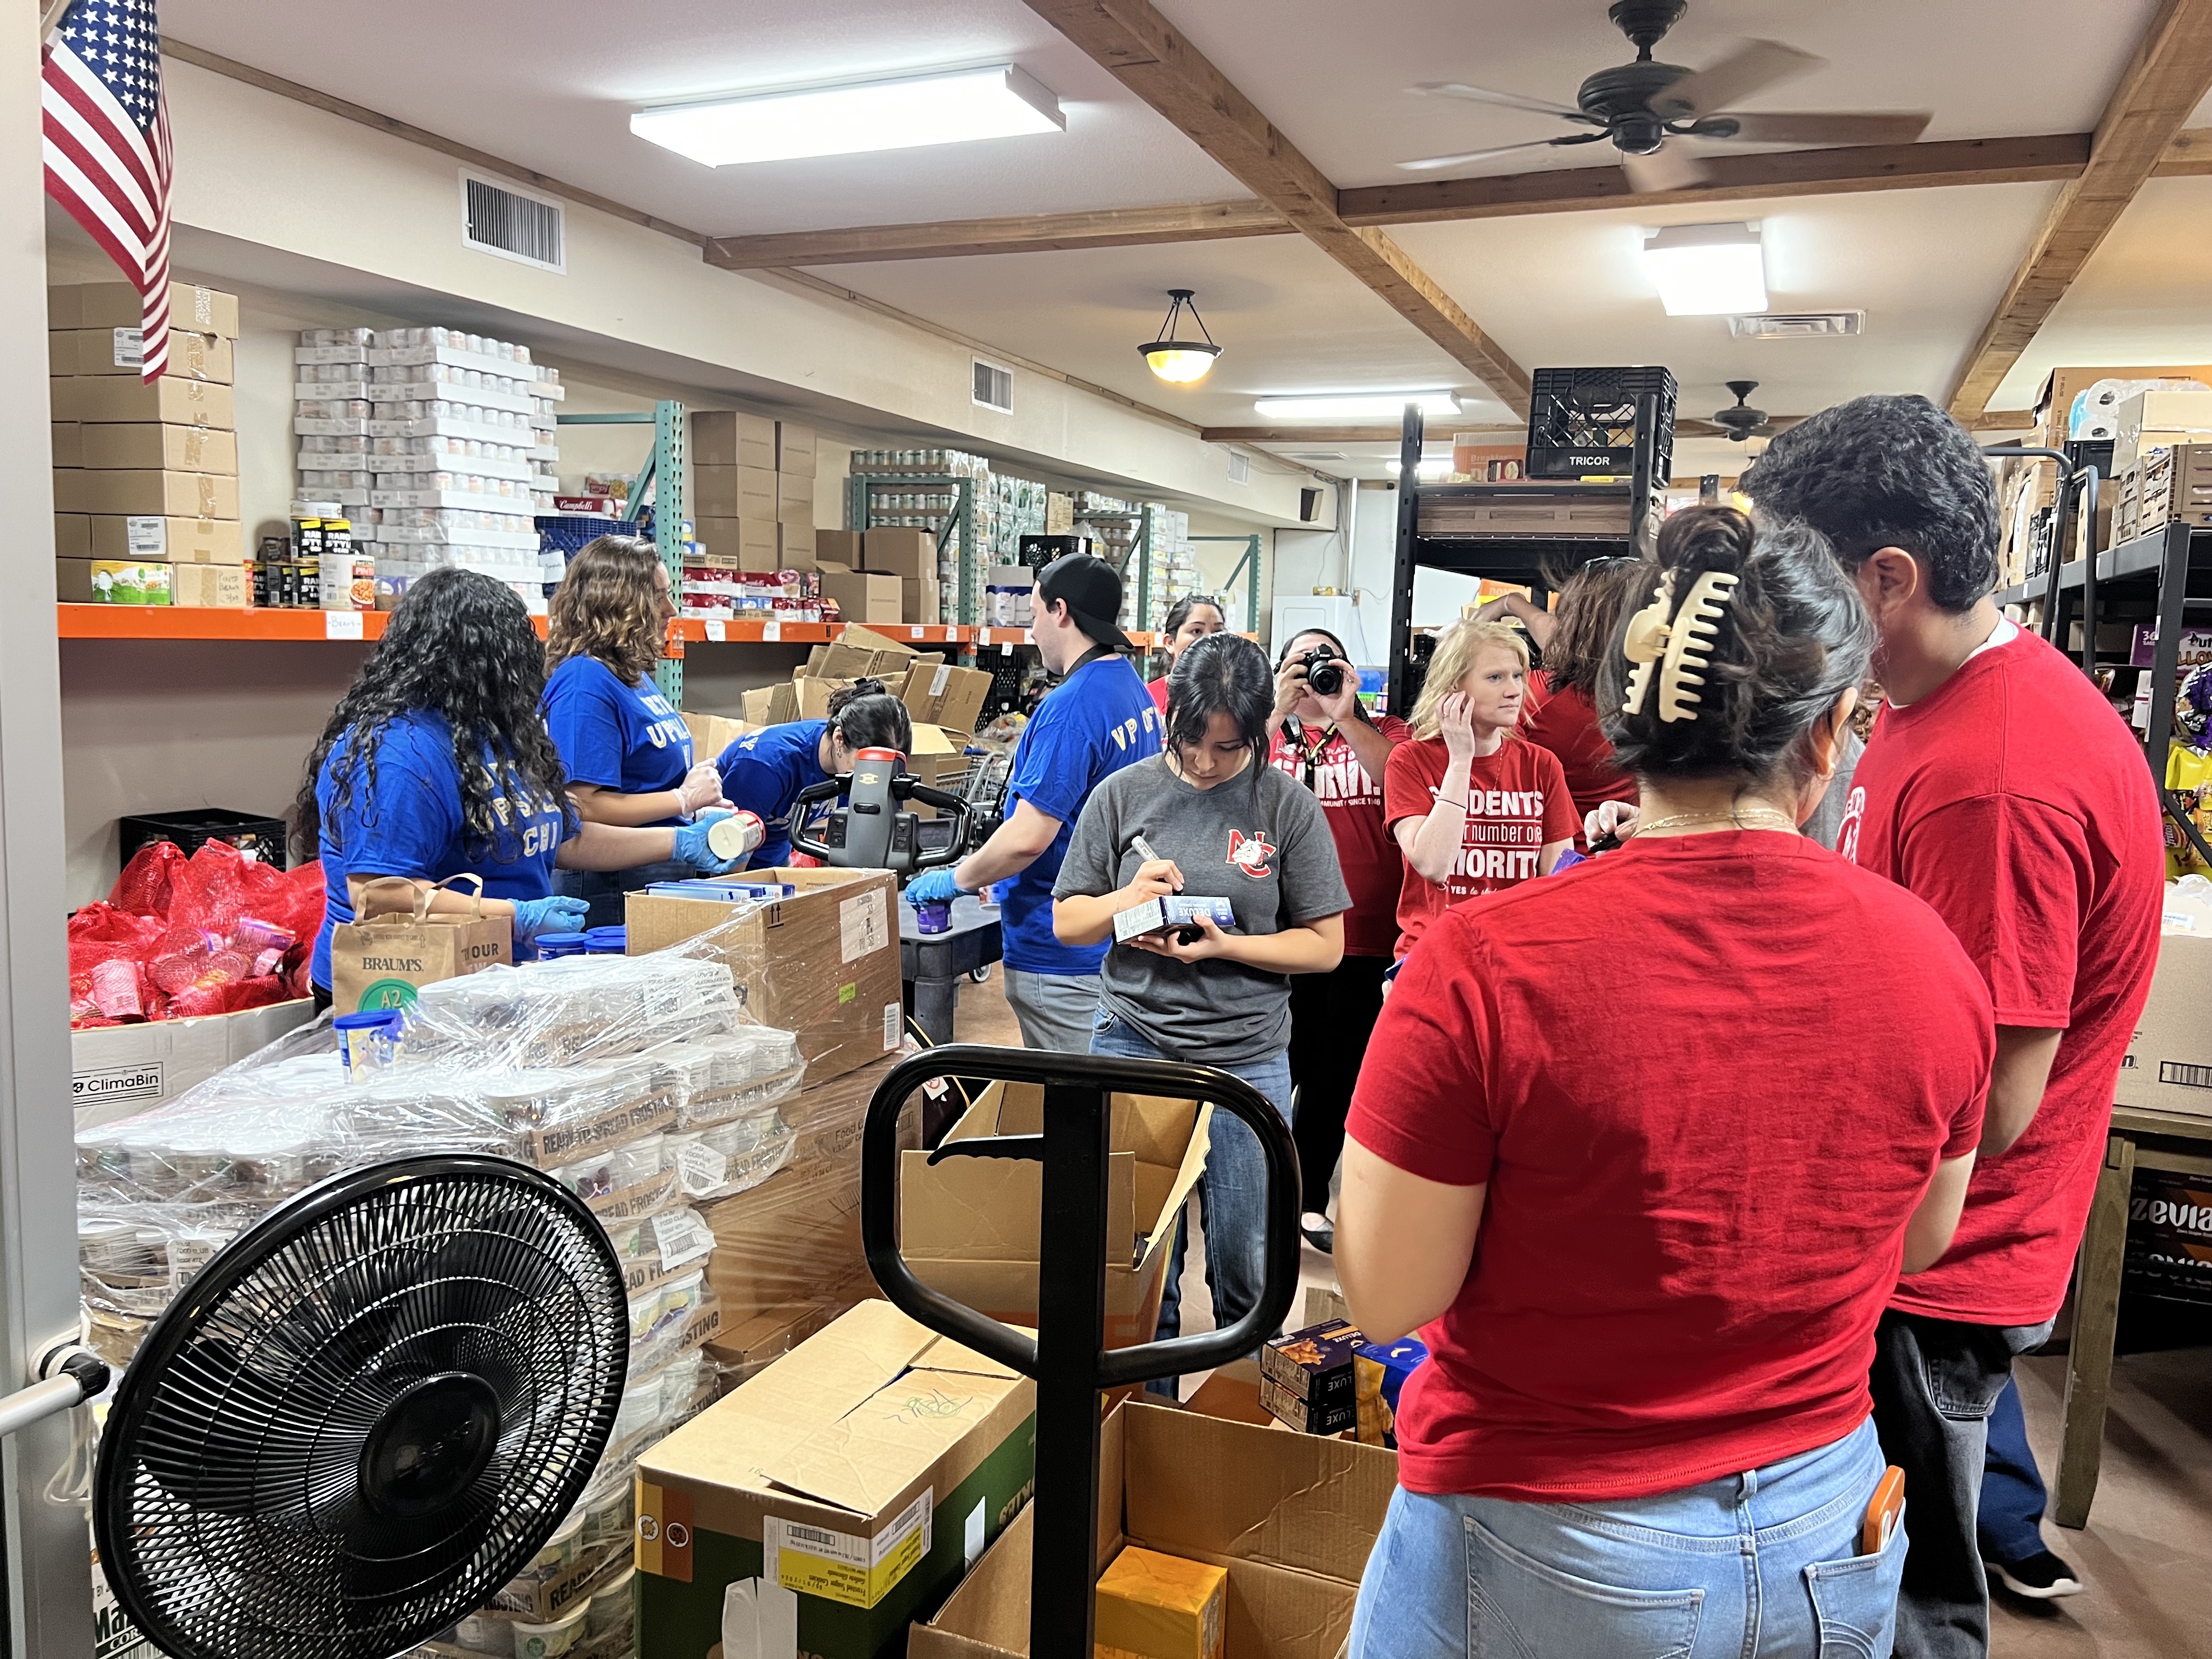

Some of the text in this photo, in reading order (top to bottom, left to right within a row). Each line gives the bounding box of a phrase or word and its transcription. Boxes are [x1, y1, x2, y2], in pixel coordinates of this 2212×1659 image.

[1570, 456, 1610, 466] TRICOR
[560, 500, 592, 512] Campbell's
[2142, 630, 2156, 641] 36
[1111, 718, 1137, 752] VP
[1348, 797, 1367, 806] SINCE
[1429, 785, 1544, 817] SDENTS
[522, 821, 558, 858] CHI
[1471, 823, 1523, 843] number
[2164, 823, 2176, 847] Fritos
[1449, 848, 1540, 879] IORITY
[1451, 885, 1467, 895] YES
[1178, 907, 1212, 917] DELUXE
[471, 943, 499, 959] OUR
[362, 957, 422, 972] BRAUM'S
[381, 989, 402, 1008] A2
[88, 1074, 159, 1092] ClimaBin
[543, 1113, 629, 1155] READY-TO-SPREAD
[629, 1093, 674, 1126] FROSTING
[835, 1122, 856, 1143] Food
[1332, 1331, 1362, 1342] DELUXE
[1327, 1376, 1352, 1392] LUXE
